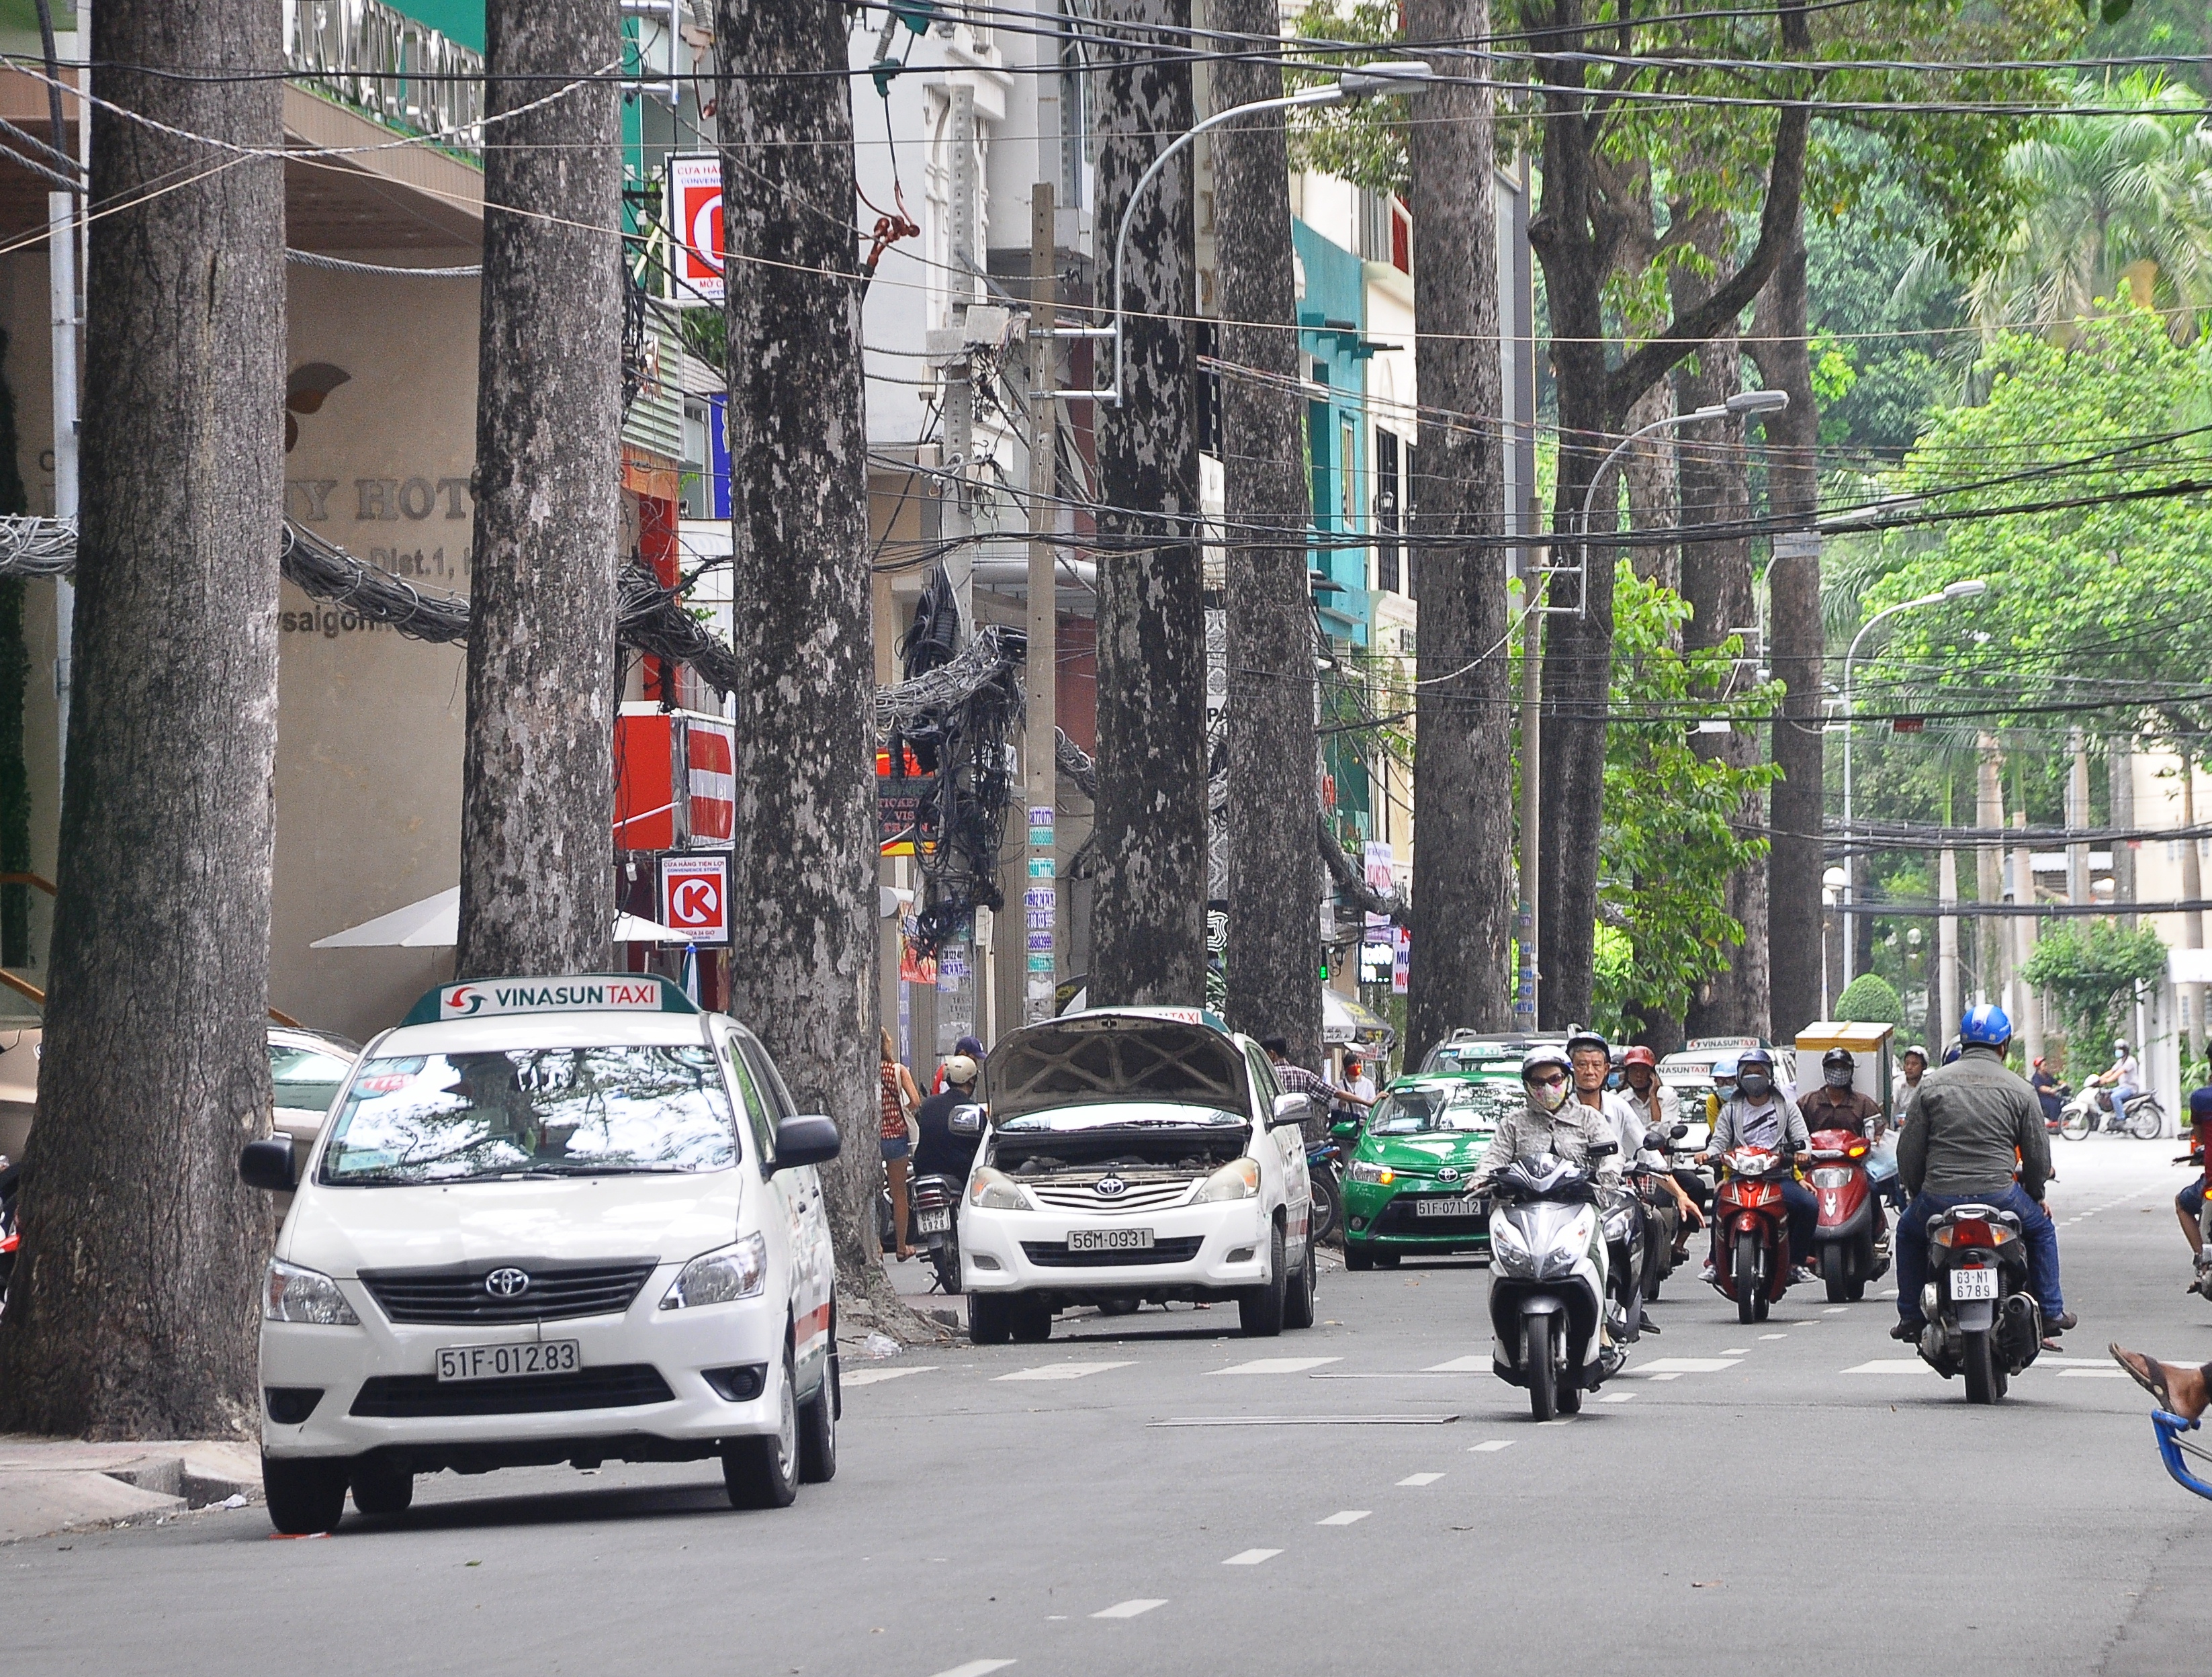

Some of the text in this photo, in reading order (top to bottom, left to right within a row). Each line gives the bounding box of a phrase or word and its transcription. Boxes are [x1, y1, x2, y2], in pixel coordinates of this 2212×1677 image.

[354, 478, 471, 520] HOT
[1957, 1284, 1990, 1298] 6789
[441, 1343, 574, 1377] 51F-012.83
